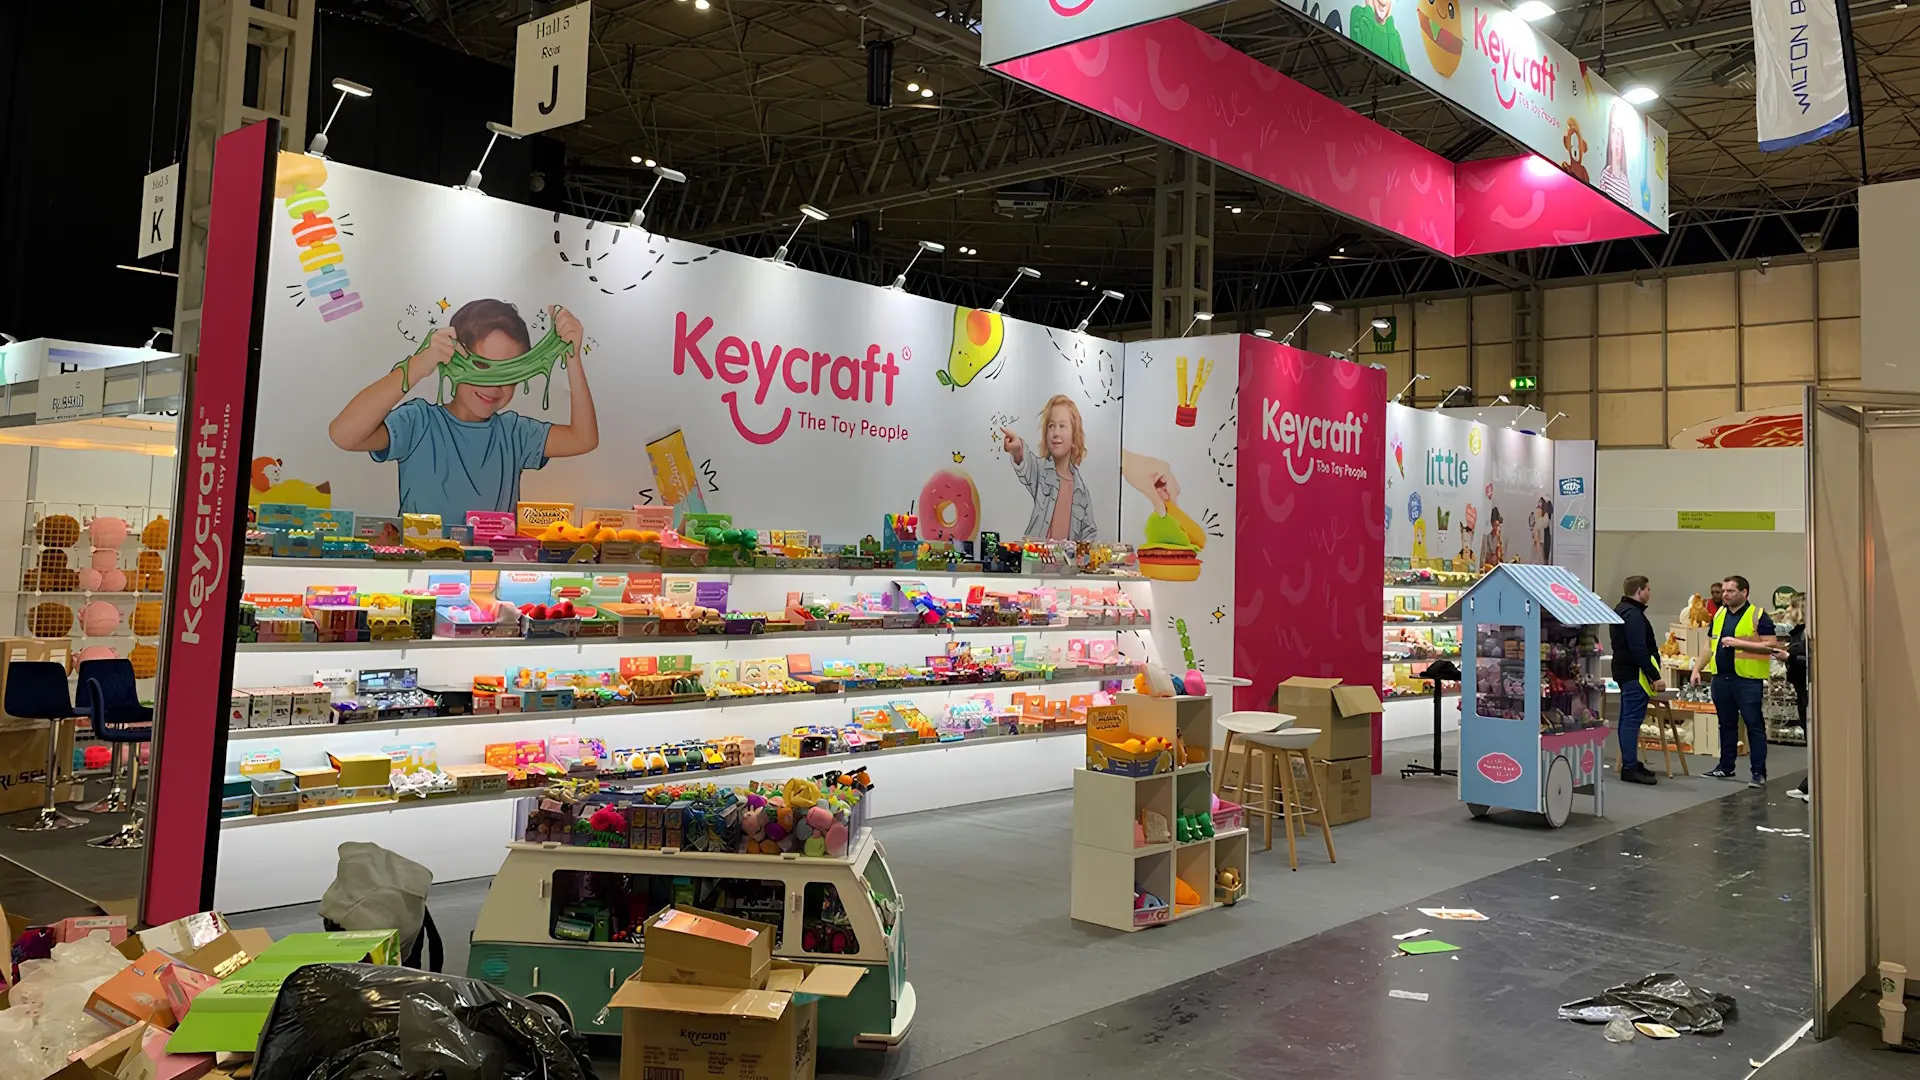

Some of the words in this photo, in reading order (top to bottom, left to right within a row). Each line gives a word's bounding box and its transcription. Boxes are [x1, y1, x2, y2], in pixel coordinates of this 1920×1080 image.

[536, 17, 560, 40] Hall
[1474, 7, 1556, 102] Keycraft
[538, 64, 559, 116] J
[151, 208, 164, 244] K
[673, 311, 900, 406] Keycraft
[798, 411, 826, 431] The
[831, 415, 856, 439] Toy
[861, 419, 909, 443] People
[1262, 397, 1364, 457] Keycraft
[217, 463, 227, 492] Toy
[1426, 447, 1469, 488] little
[181, 418, 219, 645] Keycraft
